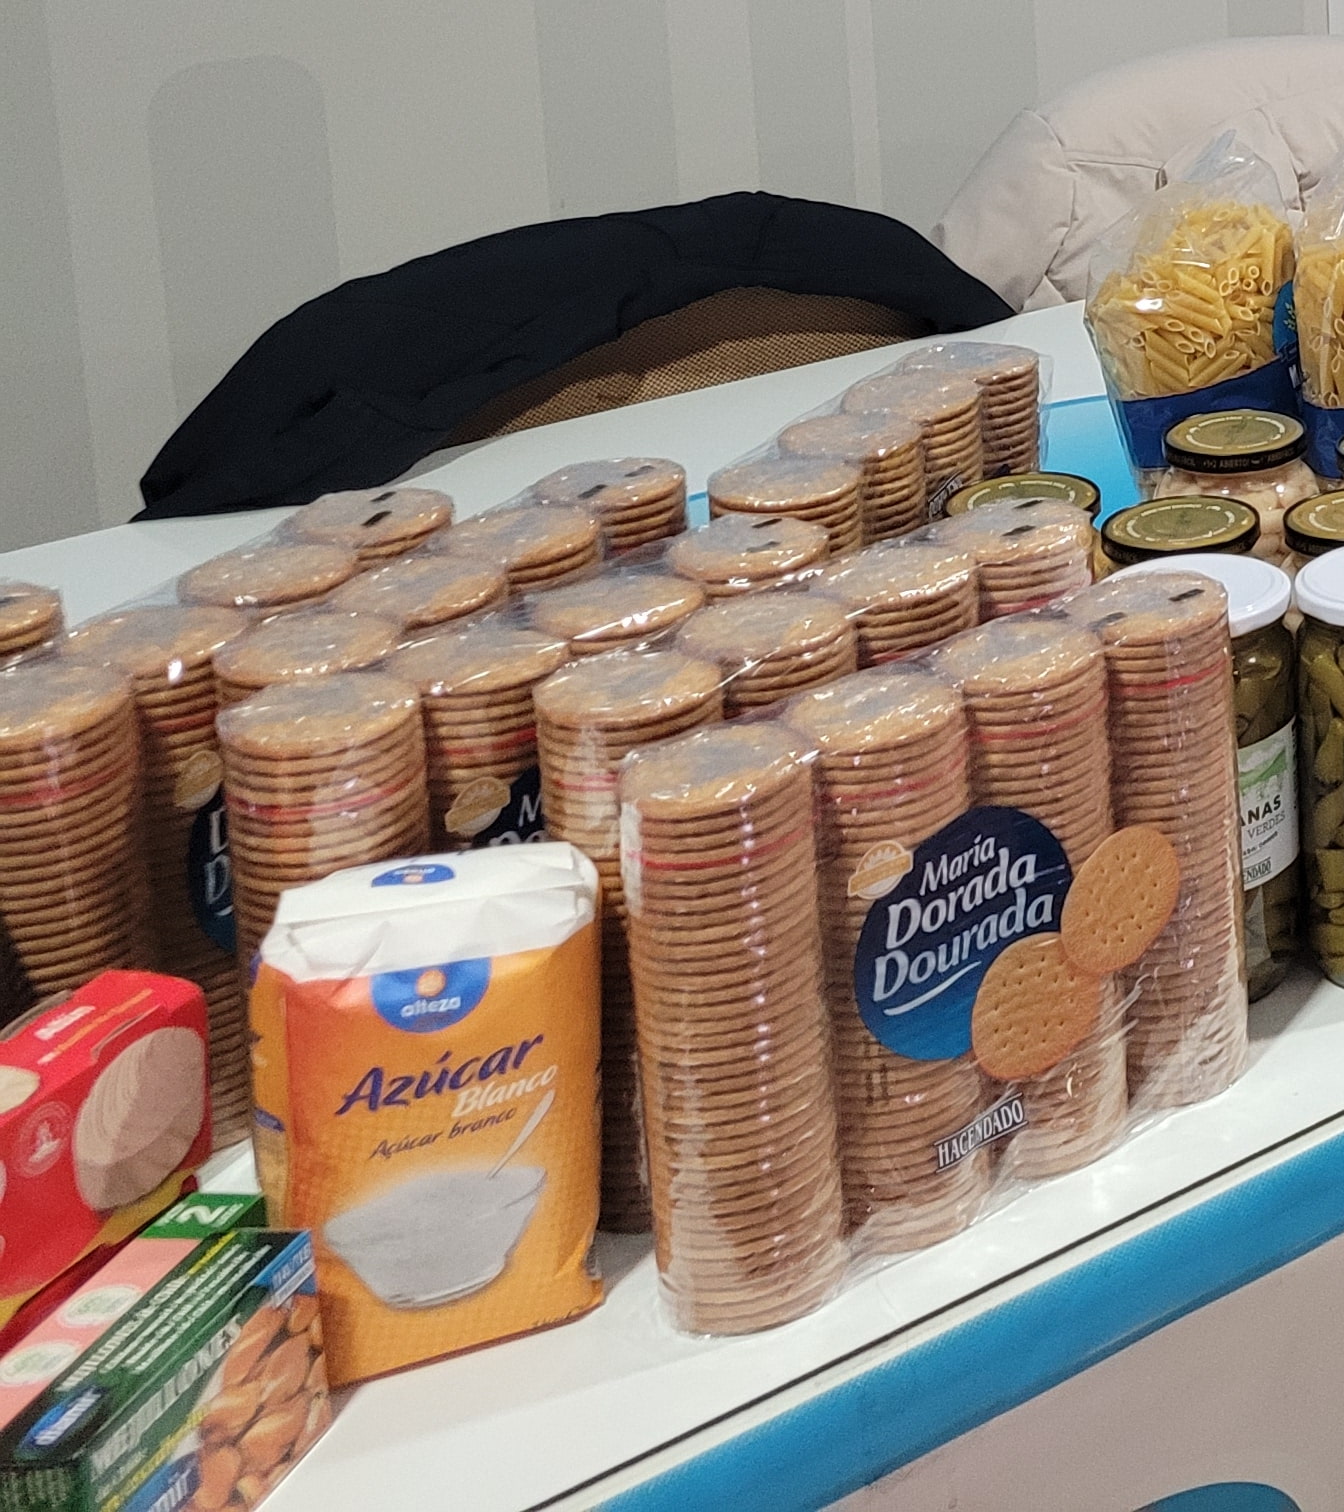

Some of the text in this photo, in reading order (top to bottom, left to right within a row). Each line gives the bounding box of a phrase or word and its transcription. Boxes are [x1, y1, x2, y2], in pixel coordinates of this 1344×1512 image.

[1247, 813, 1286, 839] VERDES
[919, 834, 996, 896] María
[886, 846, 1038, 949] Dorada
[873, 887, 1055, 1003] Dourada
[400, 995, 461, 1018] alteza
[334, 1033, 545, 1116] Azúcar
[451, 1064, 559, 1118] Blanco
[449, 1107, 518, 1140] branco
[937, 1098, 1024, 1168] HACENDADO
